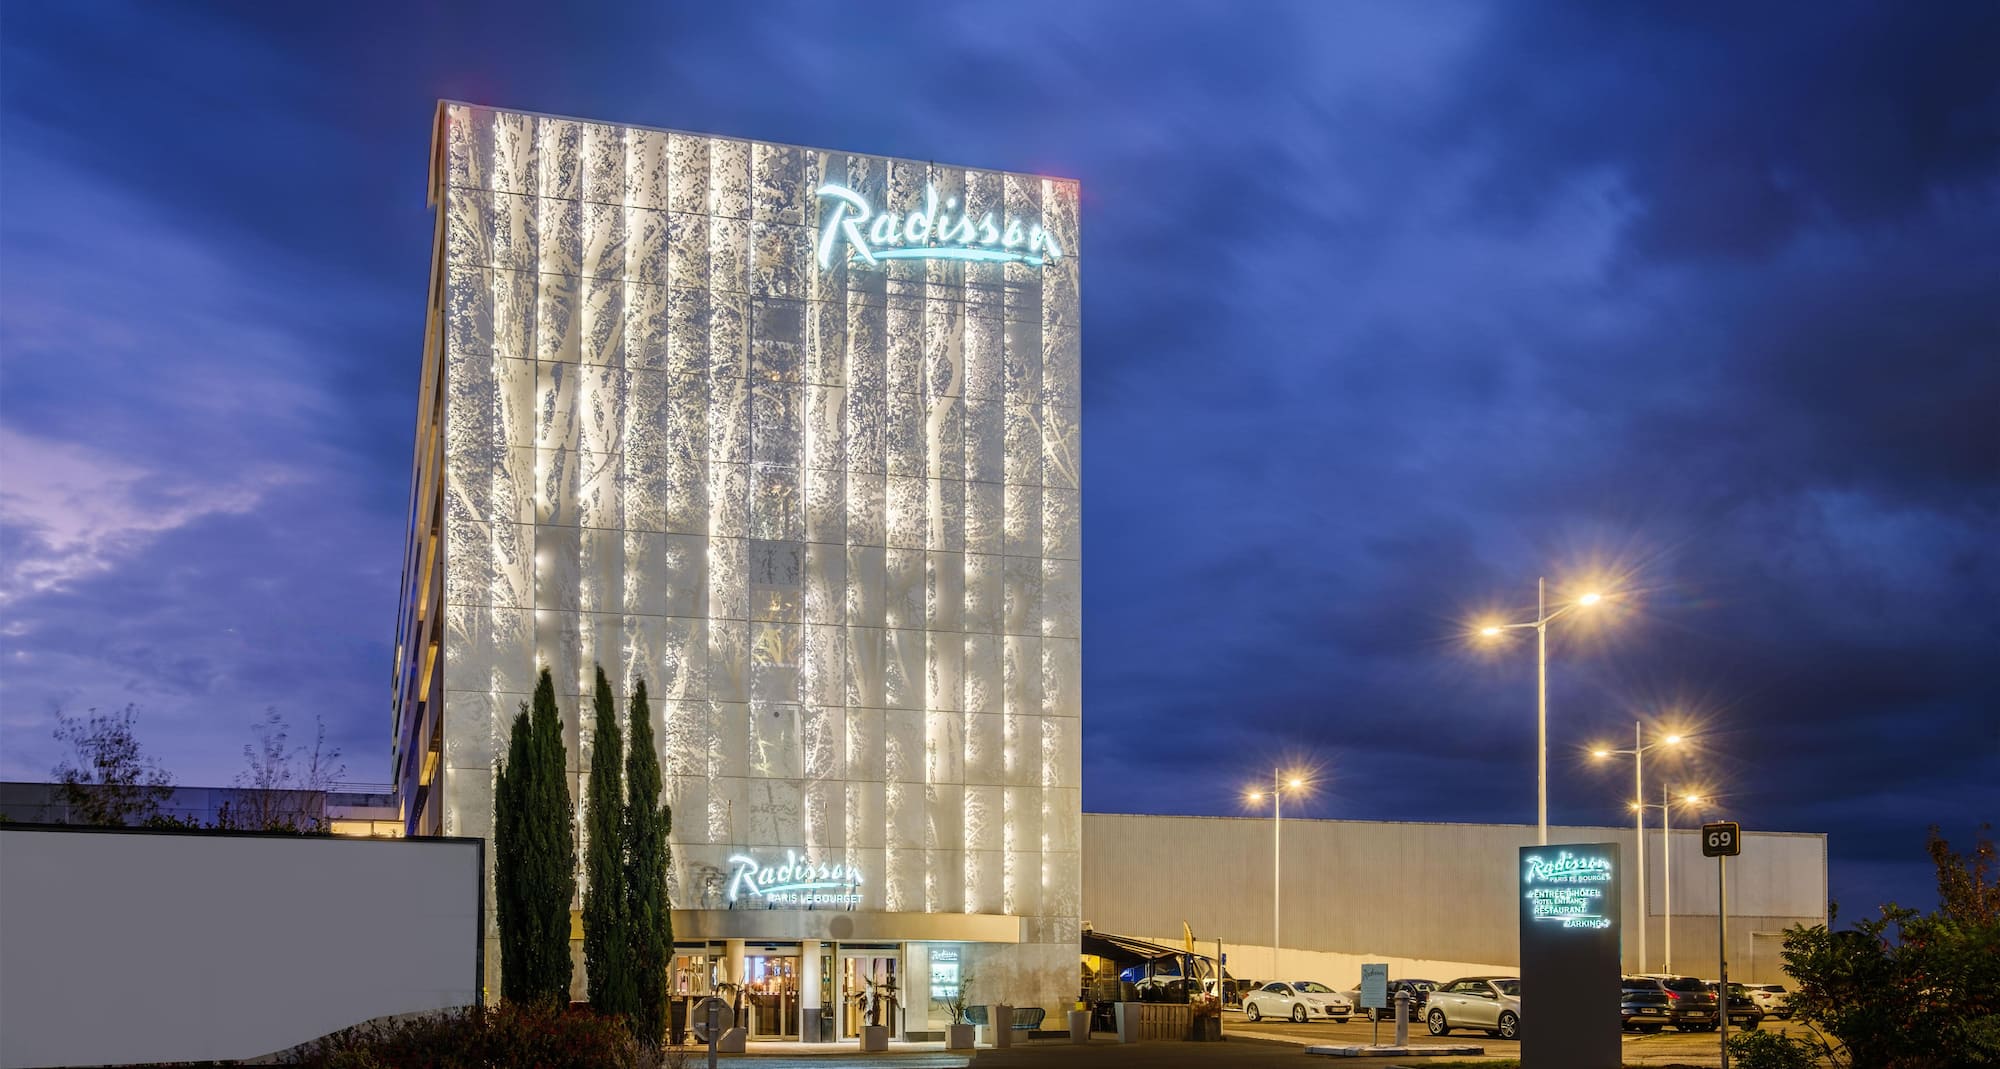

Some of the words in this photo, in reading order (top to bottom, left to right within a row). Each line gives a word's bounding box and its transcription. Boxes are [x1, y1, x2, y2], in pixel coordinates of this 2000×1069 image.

[816, 183, 1062, 270] Radisson
[1708, 831, 1732, 847] 69
[728, 849, 864, 902] Radisson
[1525, 851, 1611, 884] Radisson
[767, 894, 797, 903] PARIS
[800, 894, 812, 903] LE
[814, 894, 864, 903] BOURGET
[1534, 906, 1586, 914] RESTAURANT
[1564, 919, 1602, 928] PARKING
